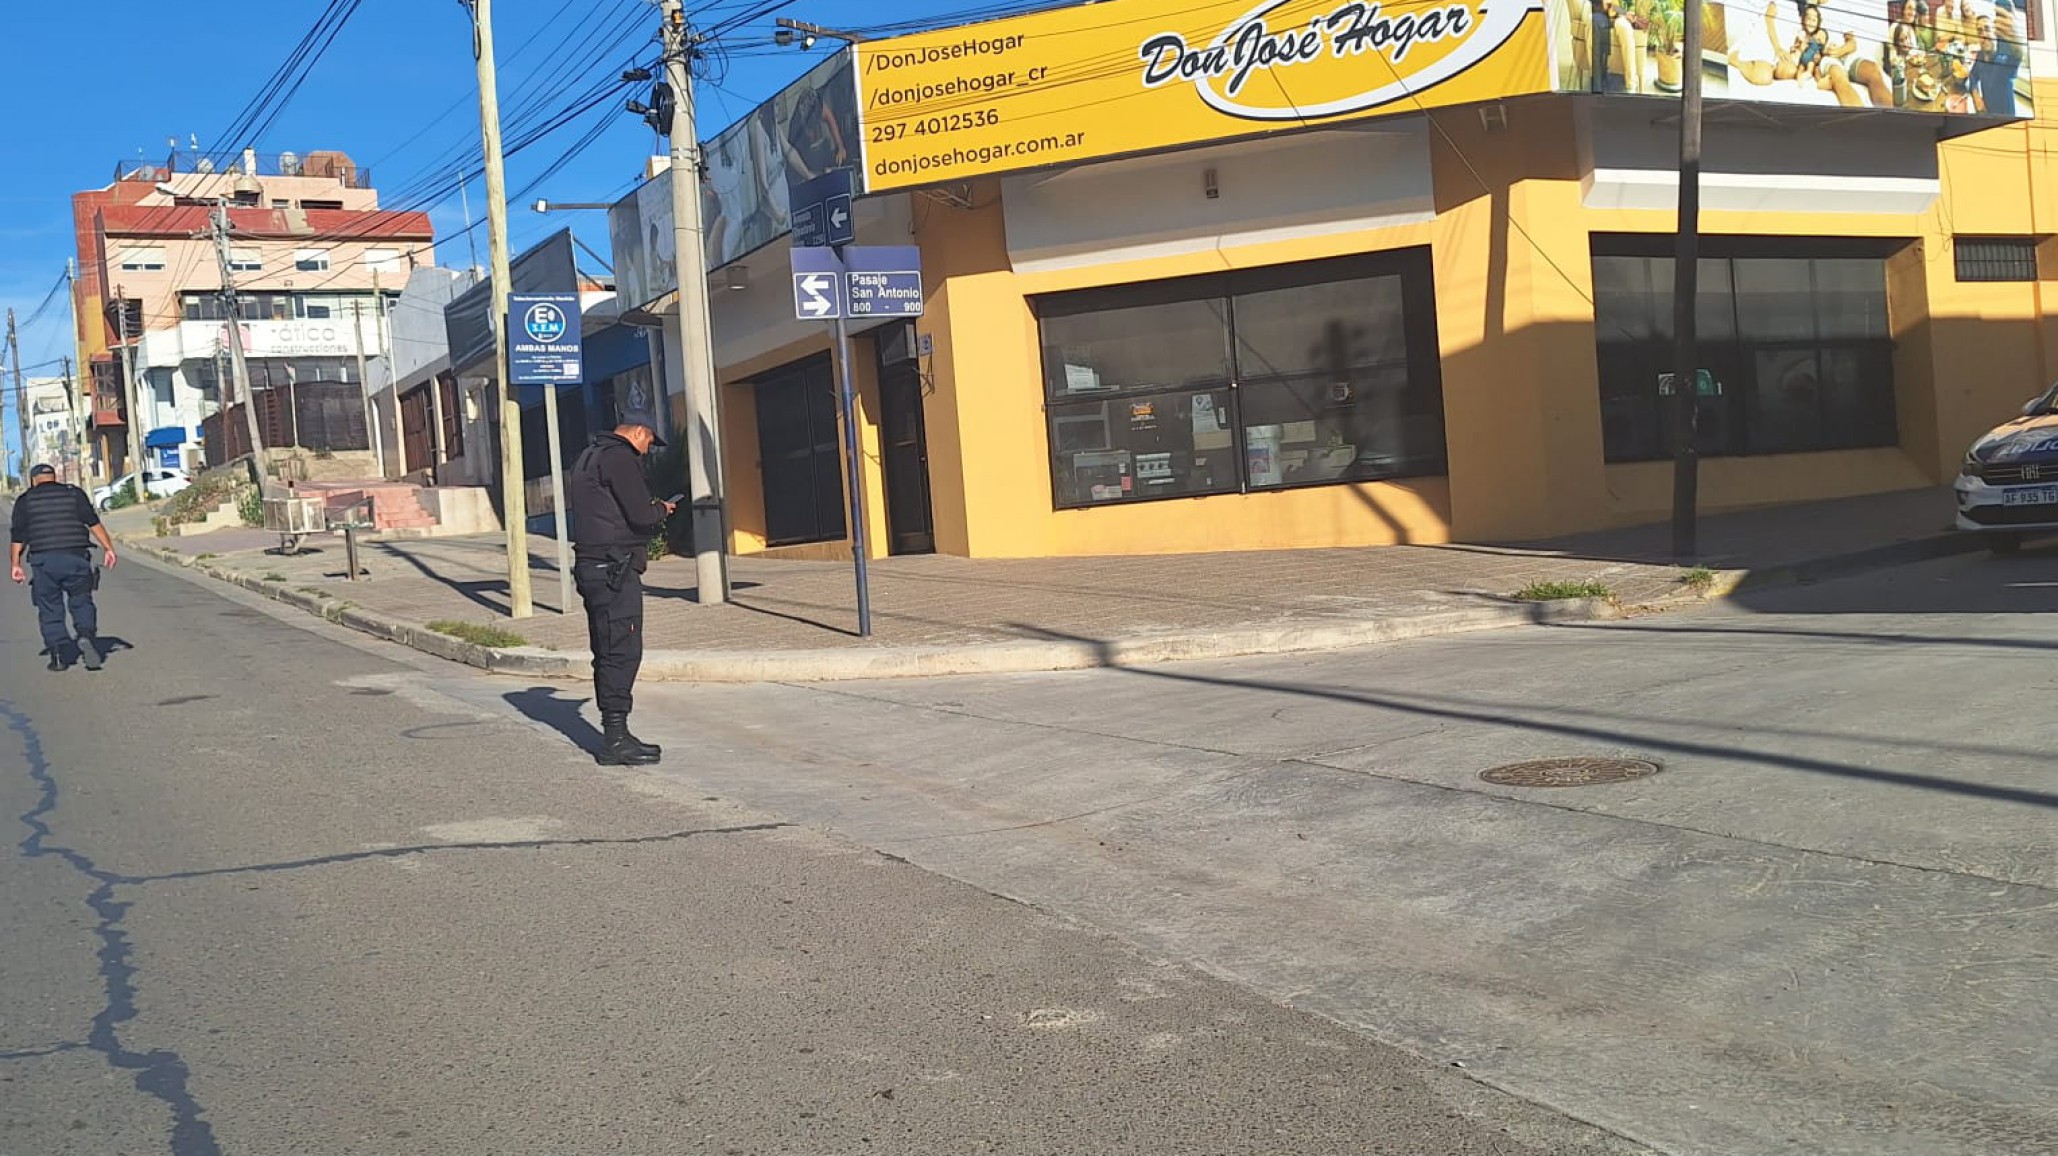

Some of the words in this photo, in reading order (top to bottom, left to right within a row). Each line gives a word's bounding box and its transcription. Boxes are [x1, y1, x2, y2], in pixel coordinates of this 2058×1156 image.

[866, 33, 1025, 76] /DonJoseHogar
[1141, 34, 1229, 84] Don
[1230, 19, 1319, 93] José
[1325, 3, 1468, 59] Hogar
[869, 64, 1048, 110] /donjosehogar_cr
[872, 122, 906, 143] 297
[913, 108, 999, 136] 4012536
[874, 129, 1085, 176] donjosehogar.com.ar
[852, 274, 887, 287] Pasaje
[852, 287, 873, 298] San
[878, 286, 919, 298] Antonio
[903, 301, 921, 312] 900
[547, 344, 579, 353] MANOS
